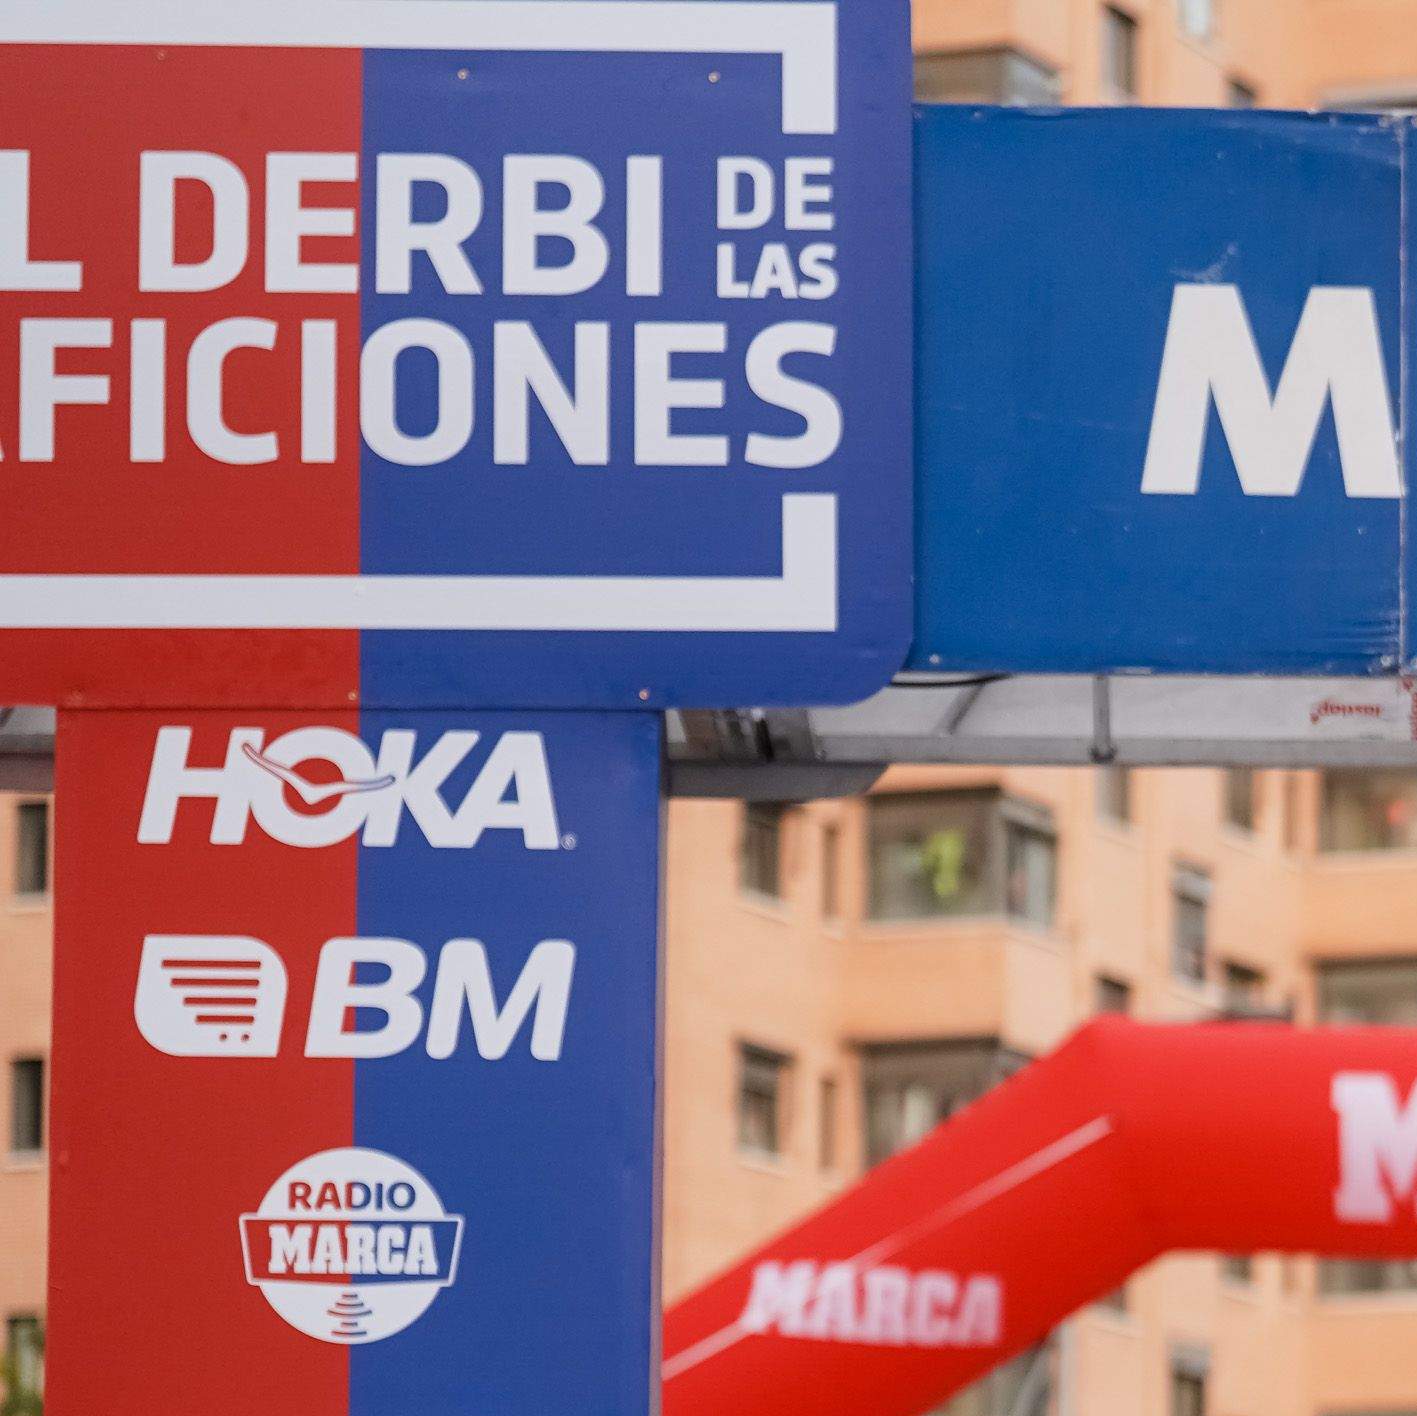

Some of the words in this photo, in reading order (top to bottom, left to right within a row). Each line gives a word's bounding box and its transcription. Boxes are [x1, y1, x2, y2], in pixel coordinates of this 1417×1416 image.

[0, 150, 82, 292] L
[139, 150, 663, 298] DERBI
[718, 156, 835, 231] DE
[717, 243, 839, 300] LAS
[0, 317, 844, 469] FICIONES
[137, 725, 560, 850] HOKA
[304, 936, 576, 1062] BM
[287, 1181, 418, 1212] RADIO
[267, 1223, 440, 1276] MARCA
[742, 1260, 1002, 1348] MARCA
